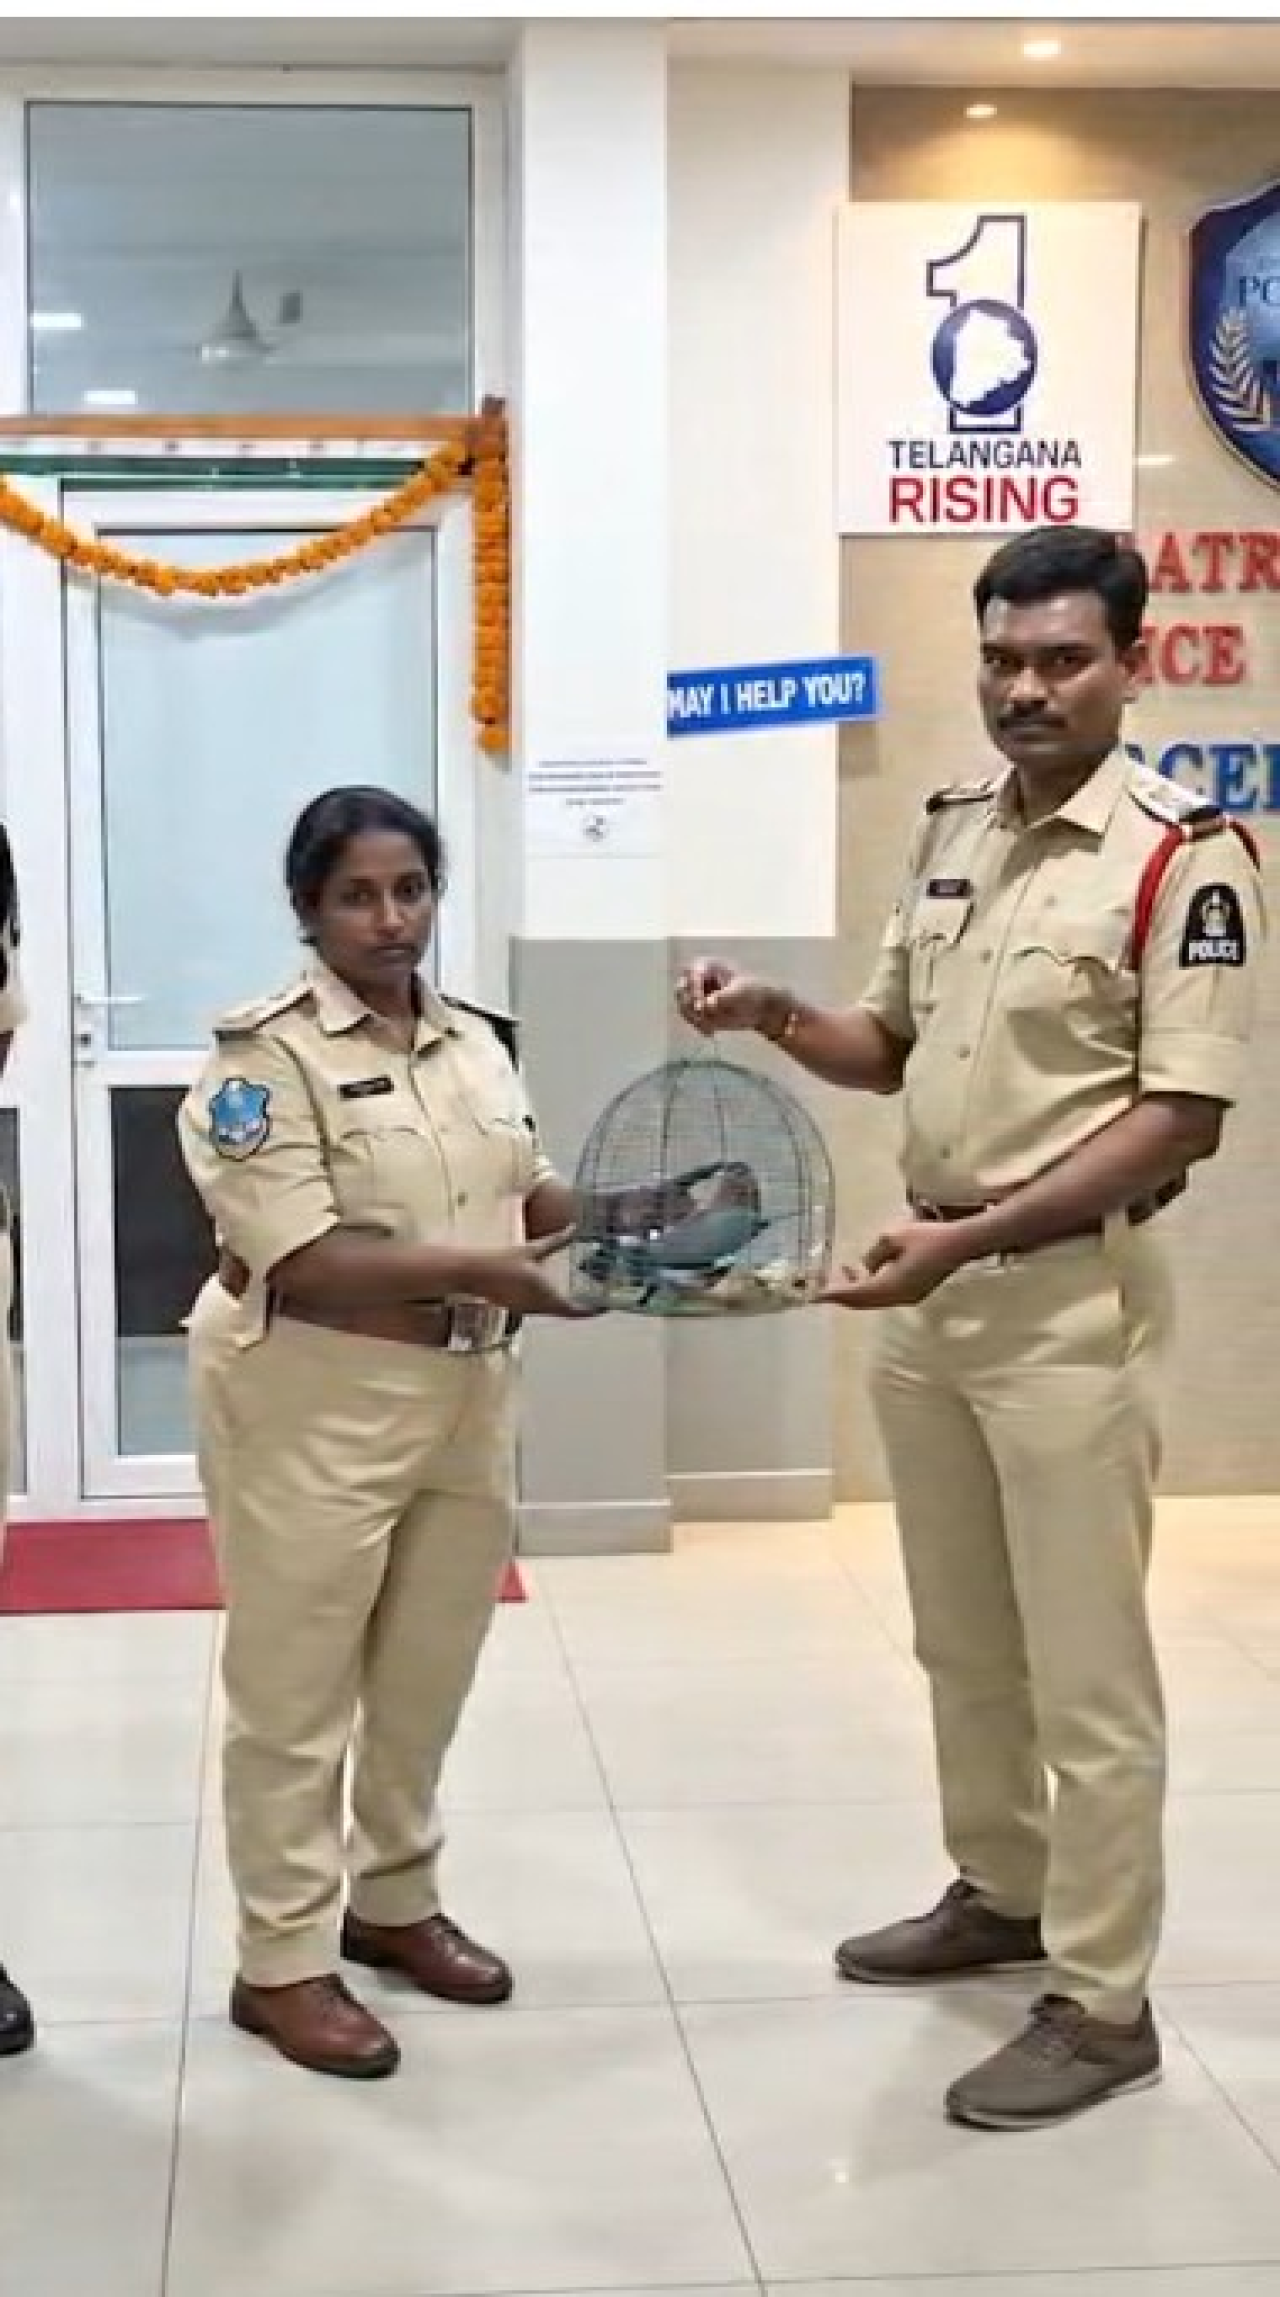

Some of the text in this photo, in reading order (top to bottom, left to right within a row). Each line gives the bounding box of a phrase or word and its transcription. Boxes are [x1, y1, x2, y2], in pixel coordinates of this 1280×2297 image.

[887, 438, 1082, 469] TELANGANA
[888, 475, 1080, 524] RISING
[1118, 531, 1280, 593] ATR
[667, 671, 866, 718] MAY I HELP YOU?
[1188, 939, 1239, 961] POLICE
